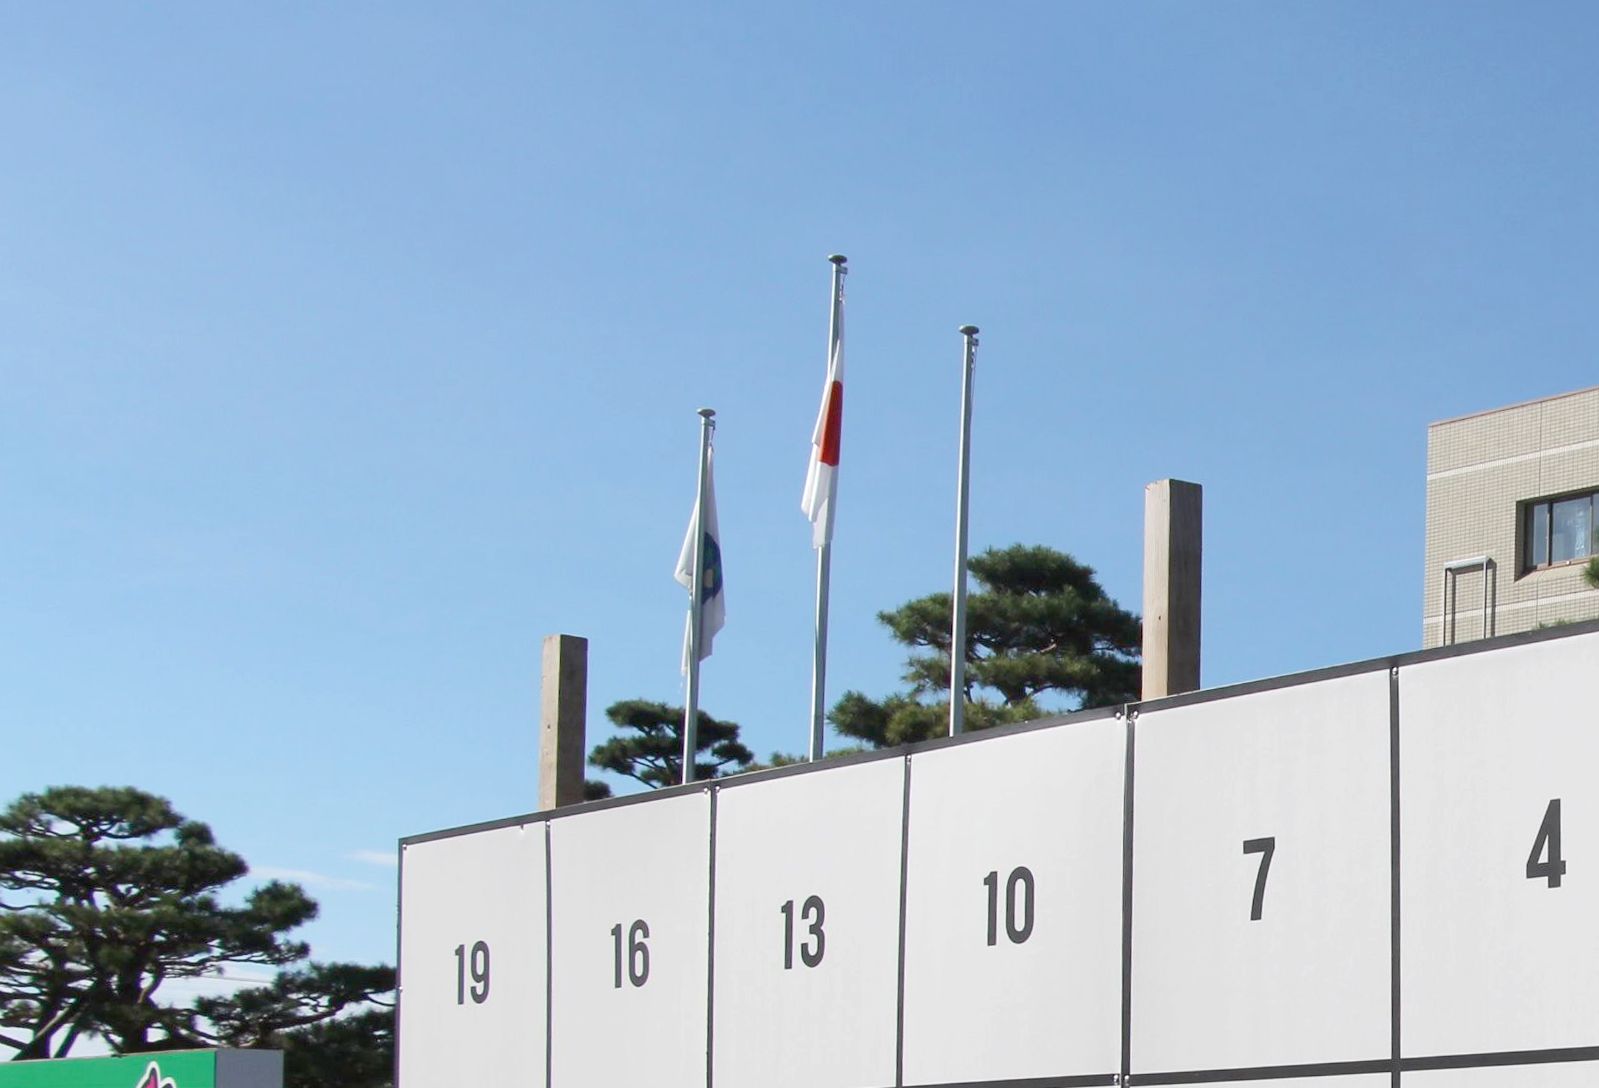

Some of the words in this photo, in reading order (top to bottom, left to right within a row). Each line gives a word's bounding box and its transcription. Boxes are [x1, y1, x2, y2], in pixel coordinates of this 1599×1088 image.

[1242, 836, 1276, 921] 7
[1525, 798, 1567, 889] 4
[780, 895, 826, 970] 13
[983, 866, 1035, 947] 10
[454, 940, 490, 1005] 19
[610, 919, 650, 989] 16
